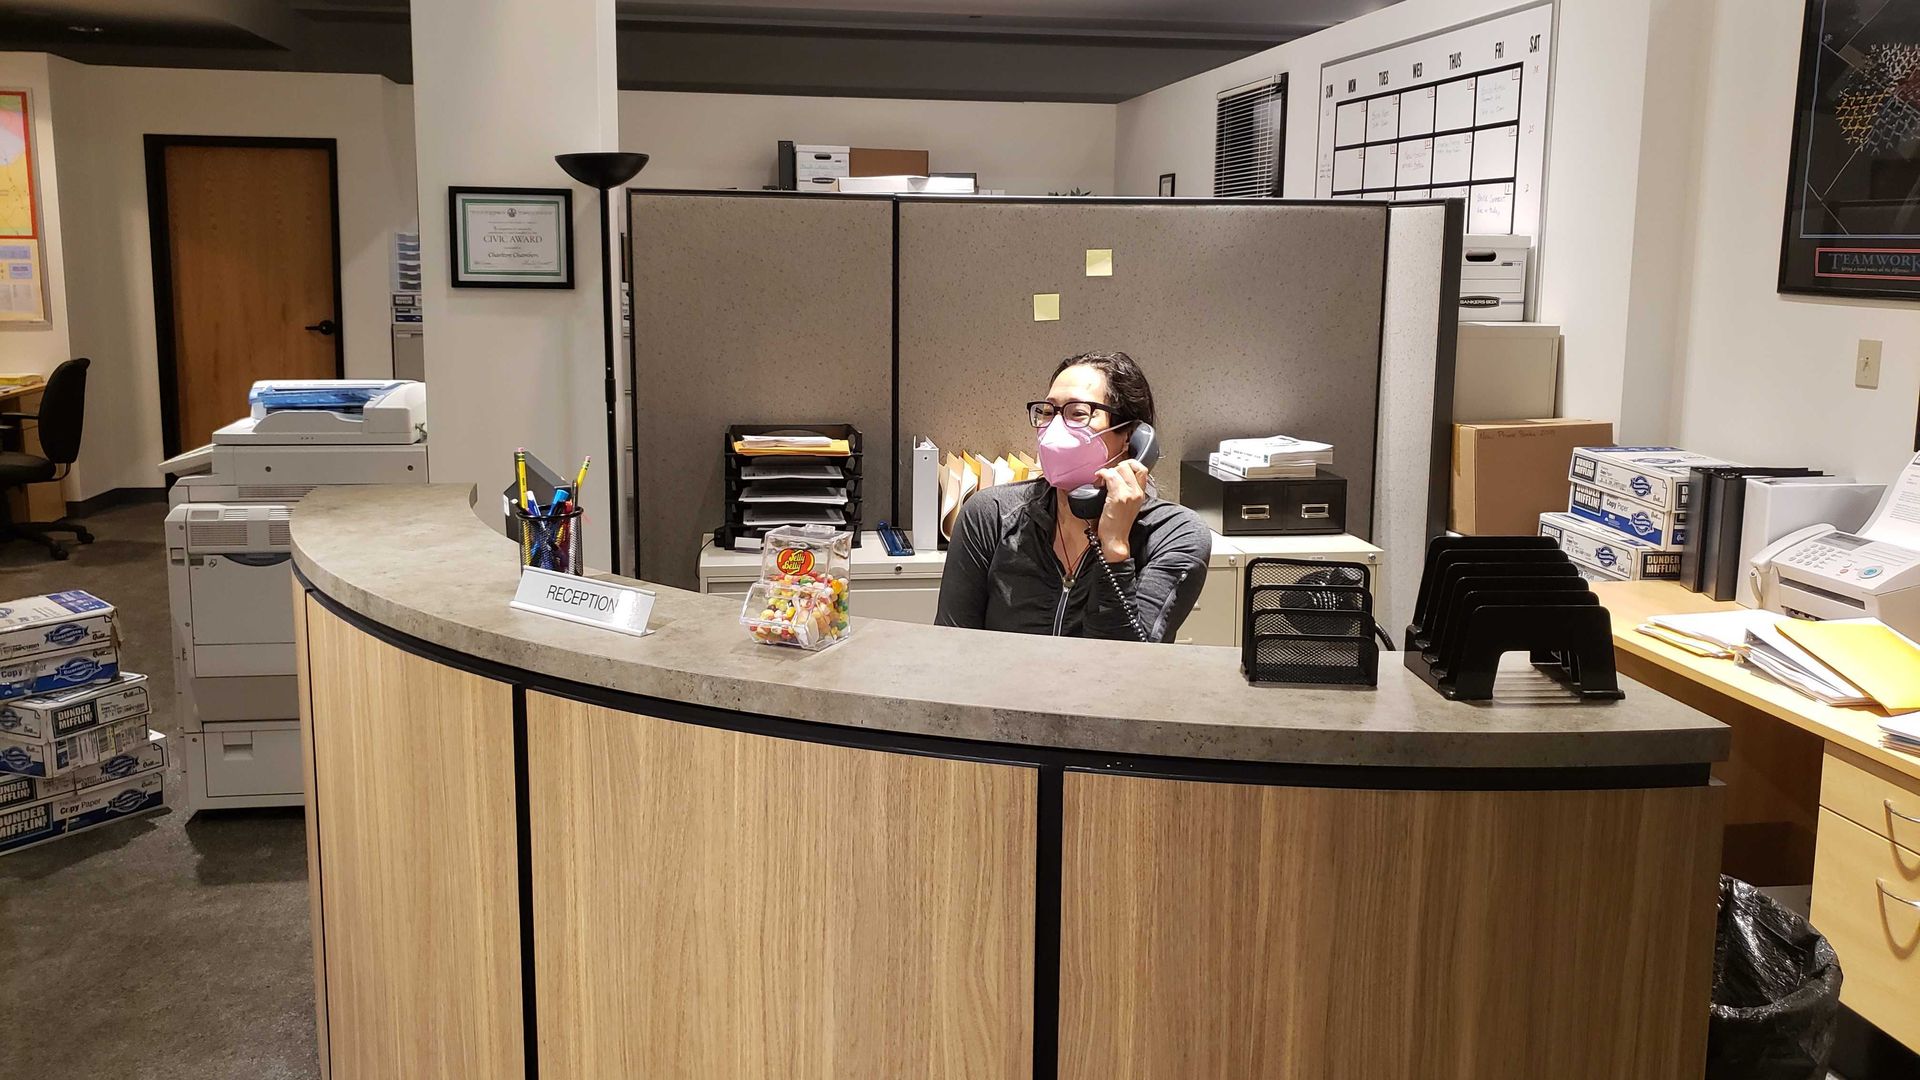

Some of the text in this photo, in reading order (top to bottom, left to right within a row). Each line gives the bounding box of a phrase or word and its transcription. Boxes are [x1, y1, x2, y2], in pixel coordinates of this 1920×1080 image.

[1348, 78, 1357, 93] MON
[1379, 70, 1389, 86] TUES
[1412, 62, 1423, 79] WED
[1495, 41, 1505, 59] FRI
[1529, 33, 1541, 53] SAT
[483, 235, 543, 243] CIVIC AWARD
[789, 551, 806, 564] Jelly
[1647, 555, 1680, 564] DUNDER
[782, 560, 801, 574] Belly
[546, 584, 619, 614] RECEPTION
[1, 668, 23, 678] Copy
[58, 704, 91, 720] DUNDER
[0, 780, 28, 794] UNDER
[81, 799, 102, 809] Paper
